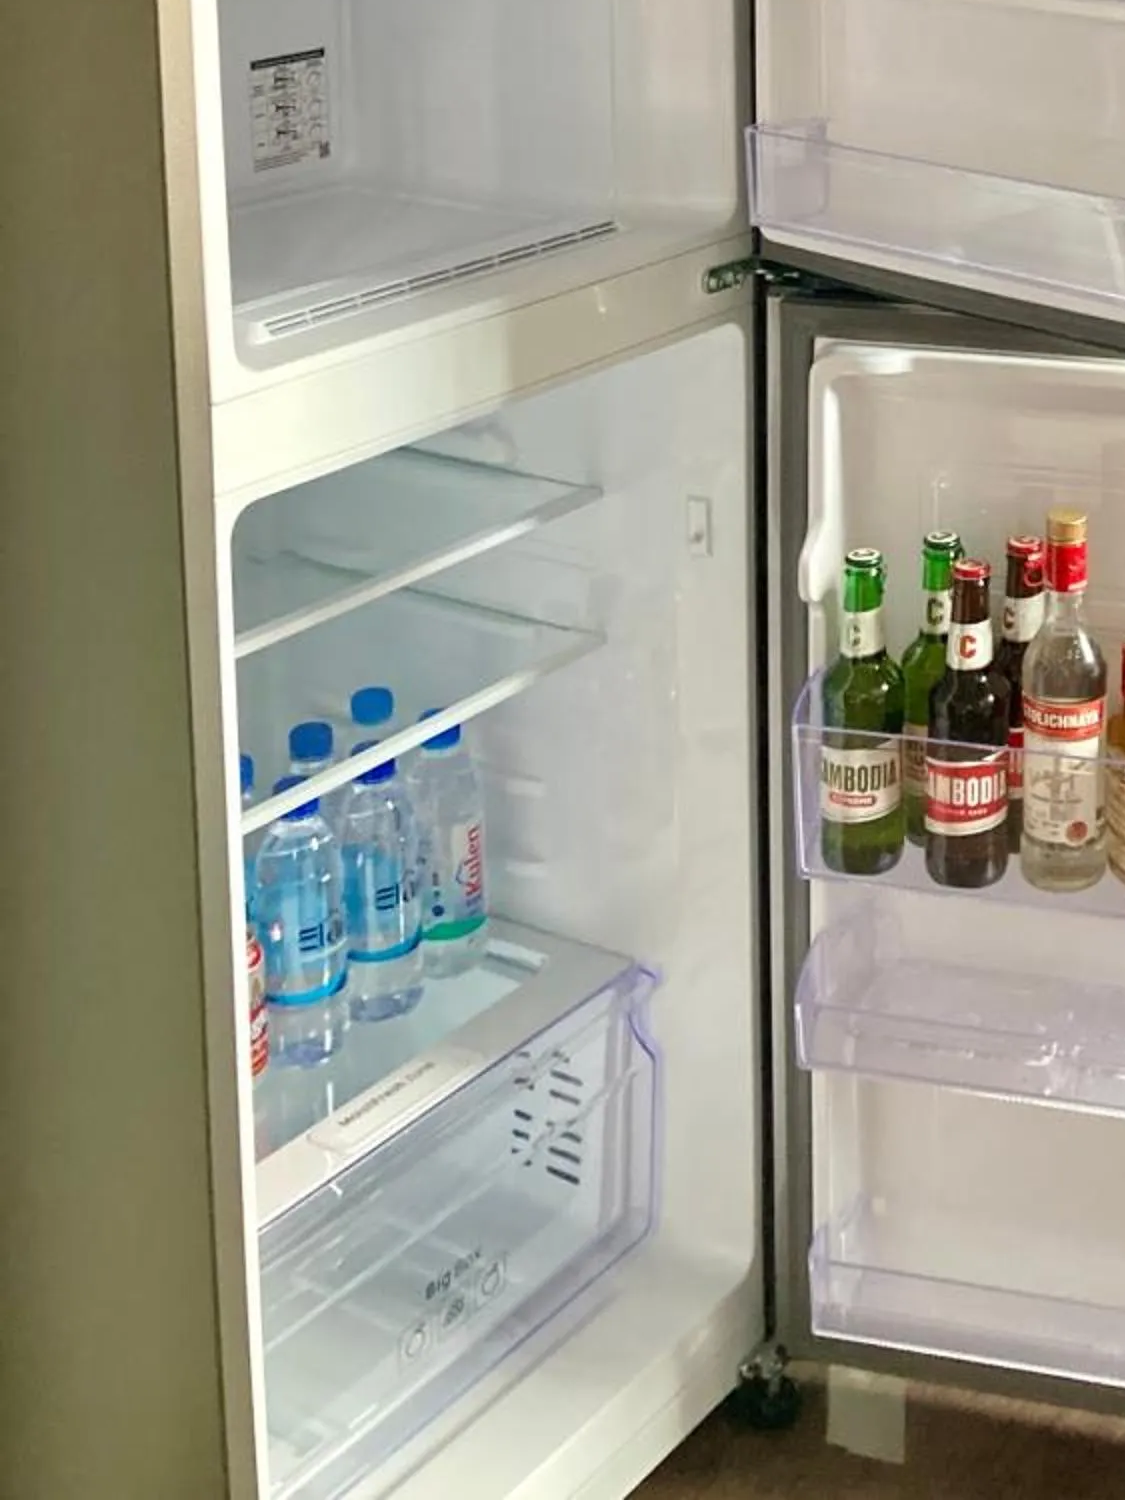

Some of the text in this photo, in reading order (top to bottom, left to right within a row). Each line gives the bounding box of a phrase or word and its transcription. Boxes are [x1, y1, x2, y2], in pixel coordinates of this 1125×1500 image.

[926, 597, 943, 626] C
[958, 634, 977, 659] C
[820, 757, 897, 793] AMBODIA
[929, 769, 1008, 808] AMBODIA
